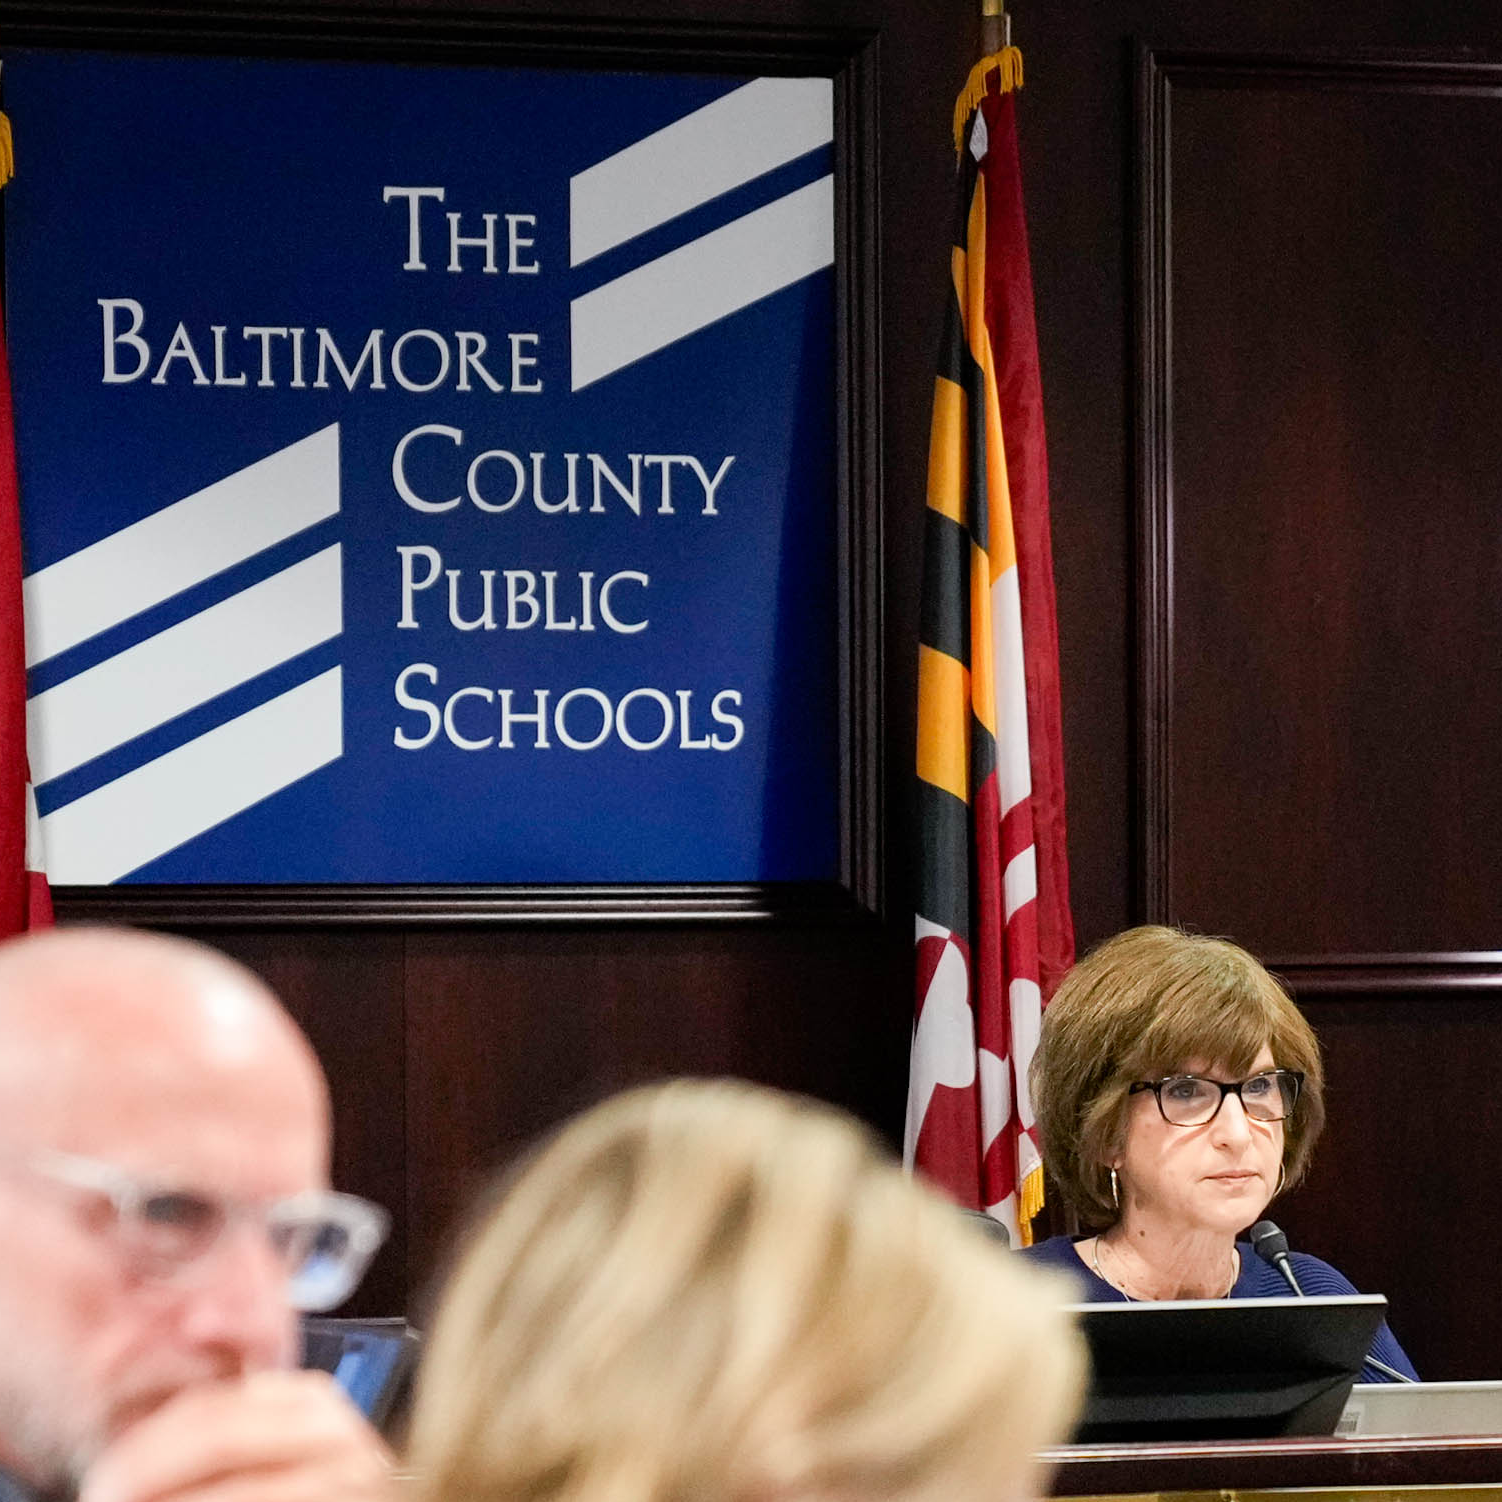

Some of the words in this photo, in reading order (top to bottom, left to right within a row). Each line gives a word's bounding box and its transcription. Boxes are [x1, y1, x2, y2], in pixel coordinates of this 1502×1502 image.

[383, 186, 540, 274] THE
[97, 298, 543, 393] BALTIMORE
[392, 424, 735, 516] COUNTY
[396, 545, 649, 634] PUBLIC
[393, 663, 745, 752] SCHOOLS
